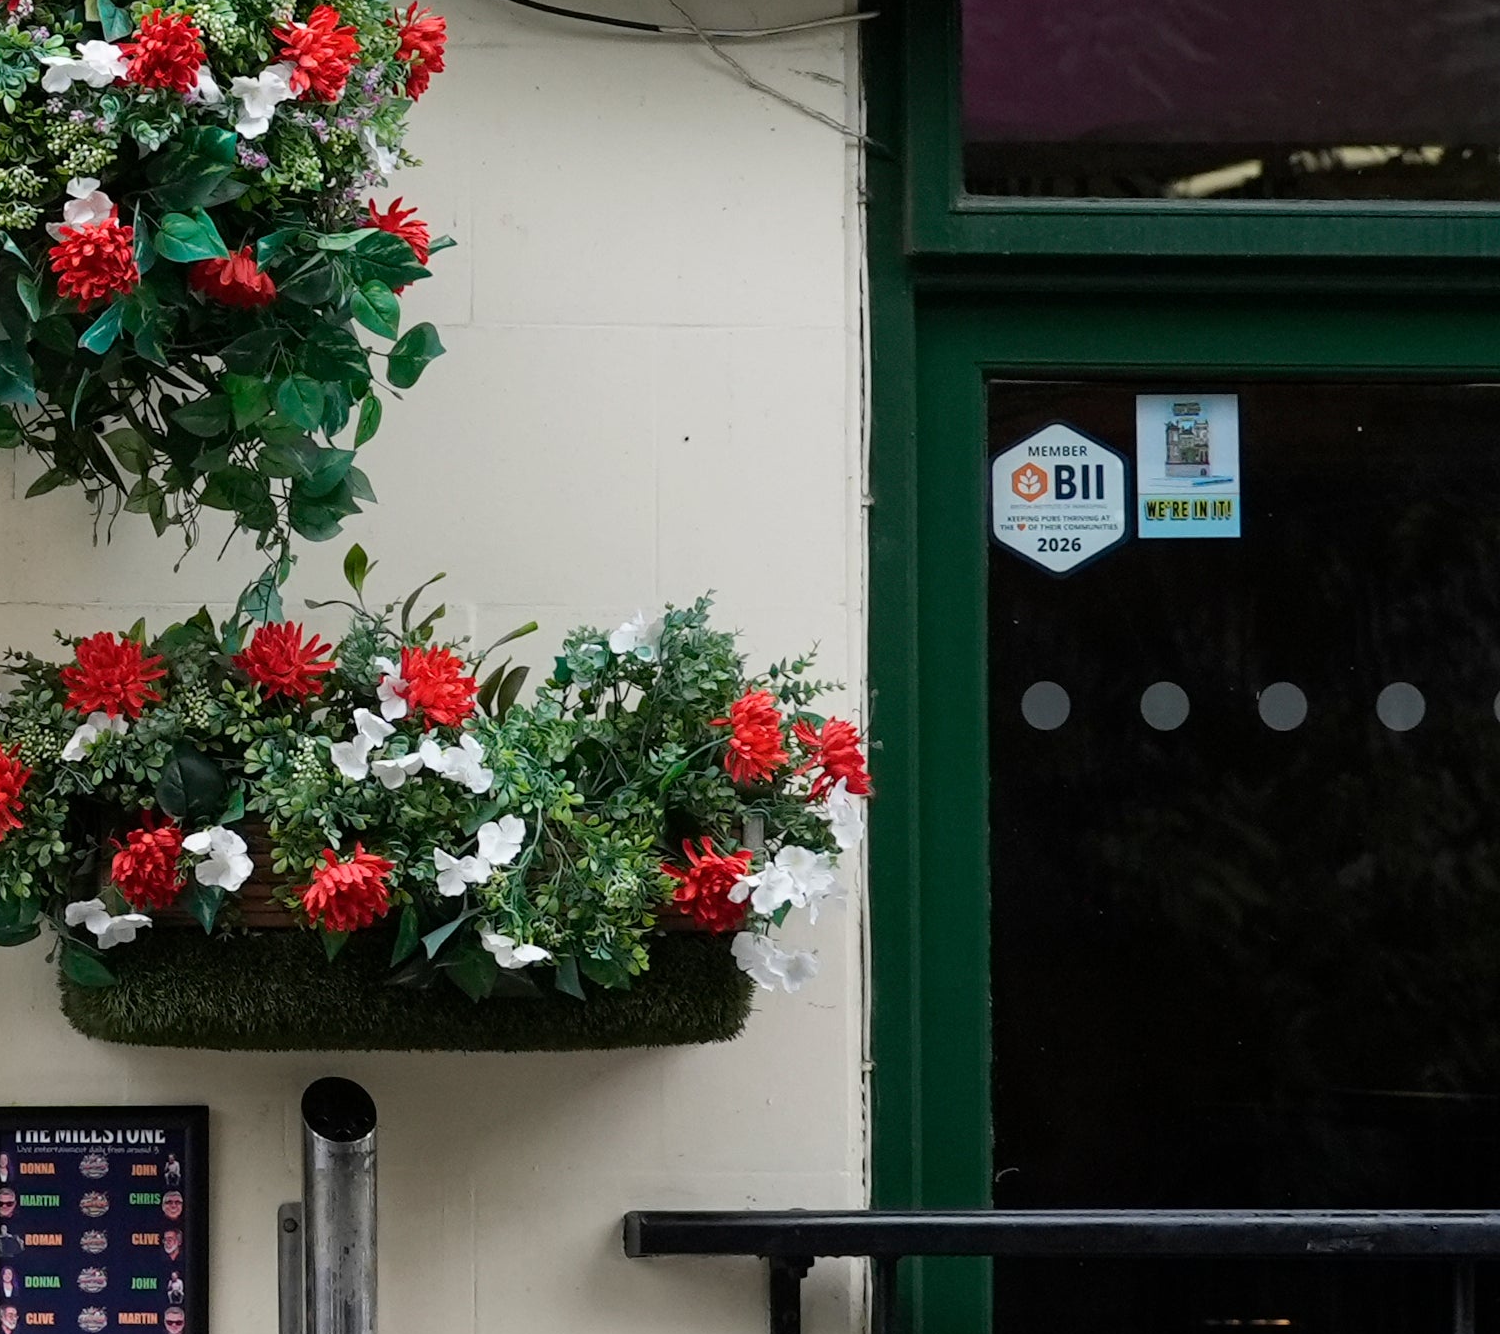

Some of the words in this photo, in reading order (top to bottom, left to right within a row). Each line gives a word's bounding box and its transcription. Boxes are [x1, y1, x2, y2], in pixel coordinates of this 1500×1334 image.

[1028, 445, 1088, 457] MEMBER
[1054, 464, 1105, 500] BII
[1146, 500, 1189, 519] WE'RE
[1193, 500, 1208, 519] IN
[1213, 500, 1232, 519] IT!
[1063, 523, 1119, 531] COMMUNITIES
[1037, 538, 1082, 552] 2026
[15, 1129, 51, 1144] THE
[54, 1129, 166, 1144] MILLSTONE
[19, 1162, 56, 1175] DONNA
[131, 1164, 158, 1176] JOHN
[19, 1195, 60, 1207] MARTIN
[129, 1193, 161, 1205] CHRIS
[24, 1233, 63, 1246] ROMAN
[131, 1233, 160, 1245] CLIVE
[24, 1276, 61, 1289] DONNA
[131, 1277, 157, 1290] JOHN
[25, 1313, 55, 1325] CLIVE
[118, 1312, 158, 1325] MARTIN
